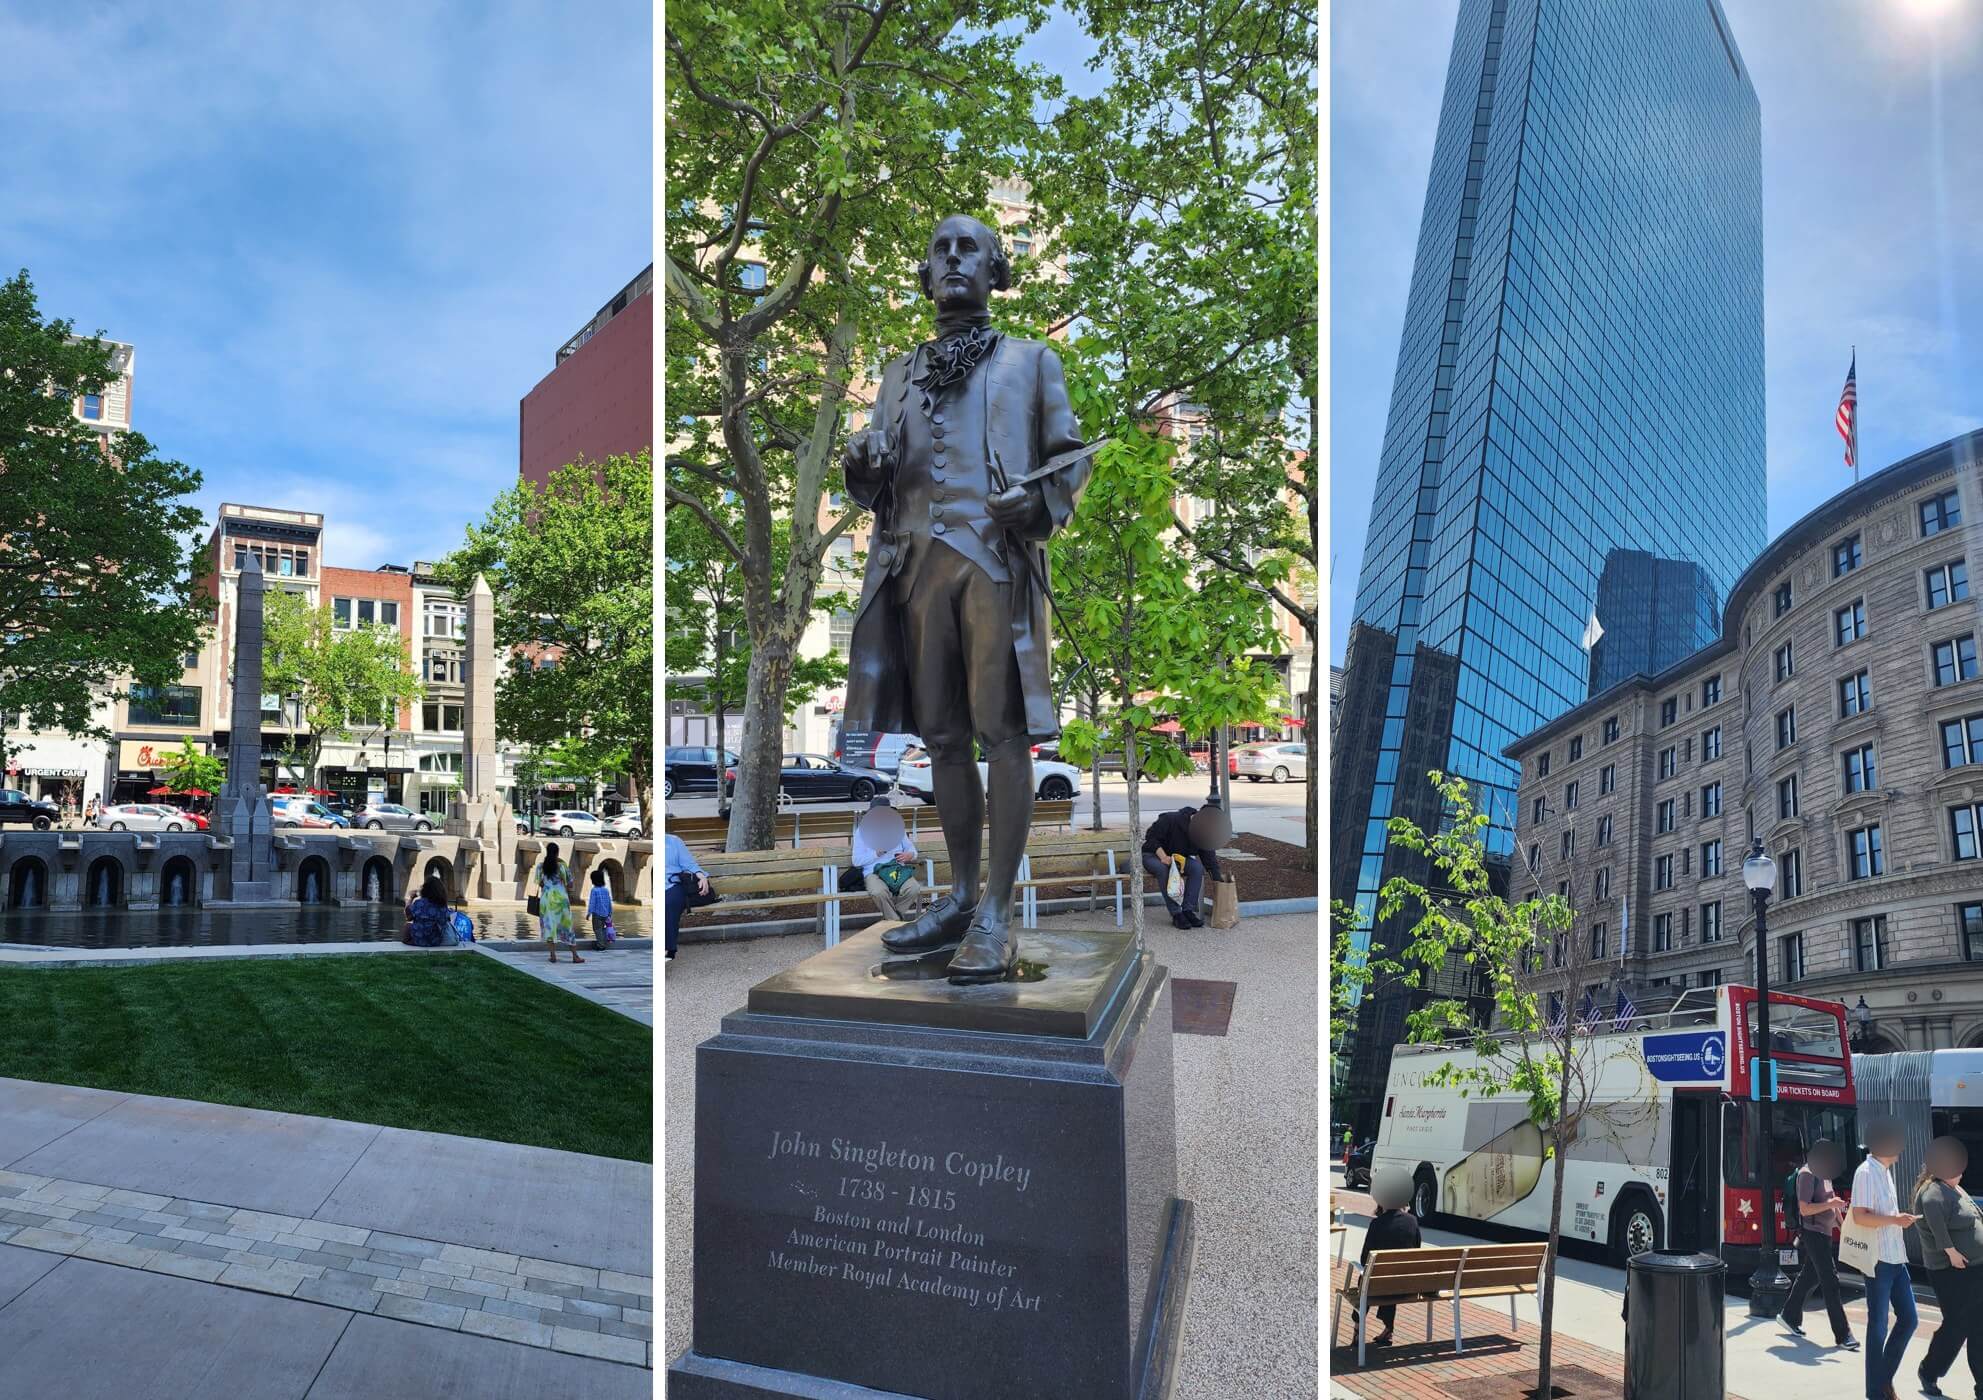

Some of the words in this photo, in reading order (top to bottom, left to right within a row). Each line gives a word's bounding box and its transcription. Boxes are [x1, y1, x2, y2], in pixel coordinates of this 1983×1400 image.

[24, 768, 61, 776] URGENT
[62, 769, 86, 777] CARE
[1789, 1086, 1812, 1096] TICKETS
[1812, 1088, 1821, 1096] ON
[1821, 1089, 1840, 1098] BOARD
[768, 1131, 820, 1160] John
[830, 1136, 937, 1174] Singleton
[945, 1151, 1032, 1192] Copley
[1656, 1168, 1669, 1180] 802
[838, 1177, 886, 1201] 1738
[906, 1185, 956, 1211] 1815
[814, 1205, 871, 1230] Boston
[876, 1216, 910, 1236] and
[916, 1219, 985, 1247] London
[786, 1228, 867, 1256] American
[872, 1239, 943, 1267] Portrait
[950, 1251, 1017, 1278] Painter
[768, 1250, 838, 1278] Member
[842, 1262, 893, 1289] Royal
[896, 1271, 981, 1307] Academy
[986, 1286, 1007, 1311] of
[1011, 1289, 1041, 1311] Art
